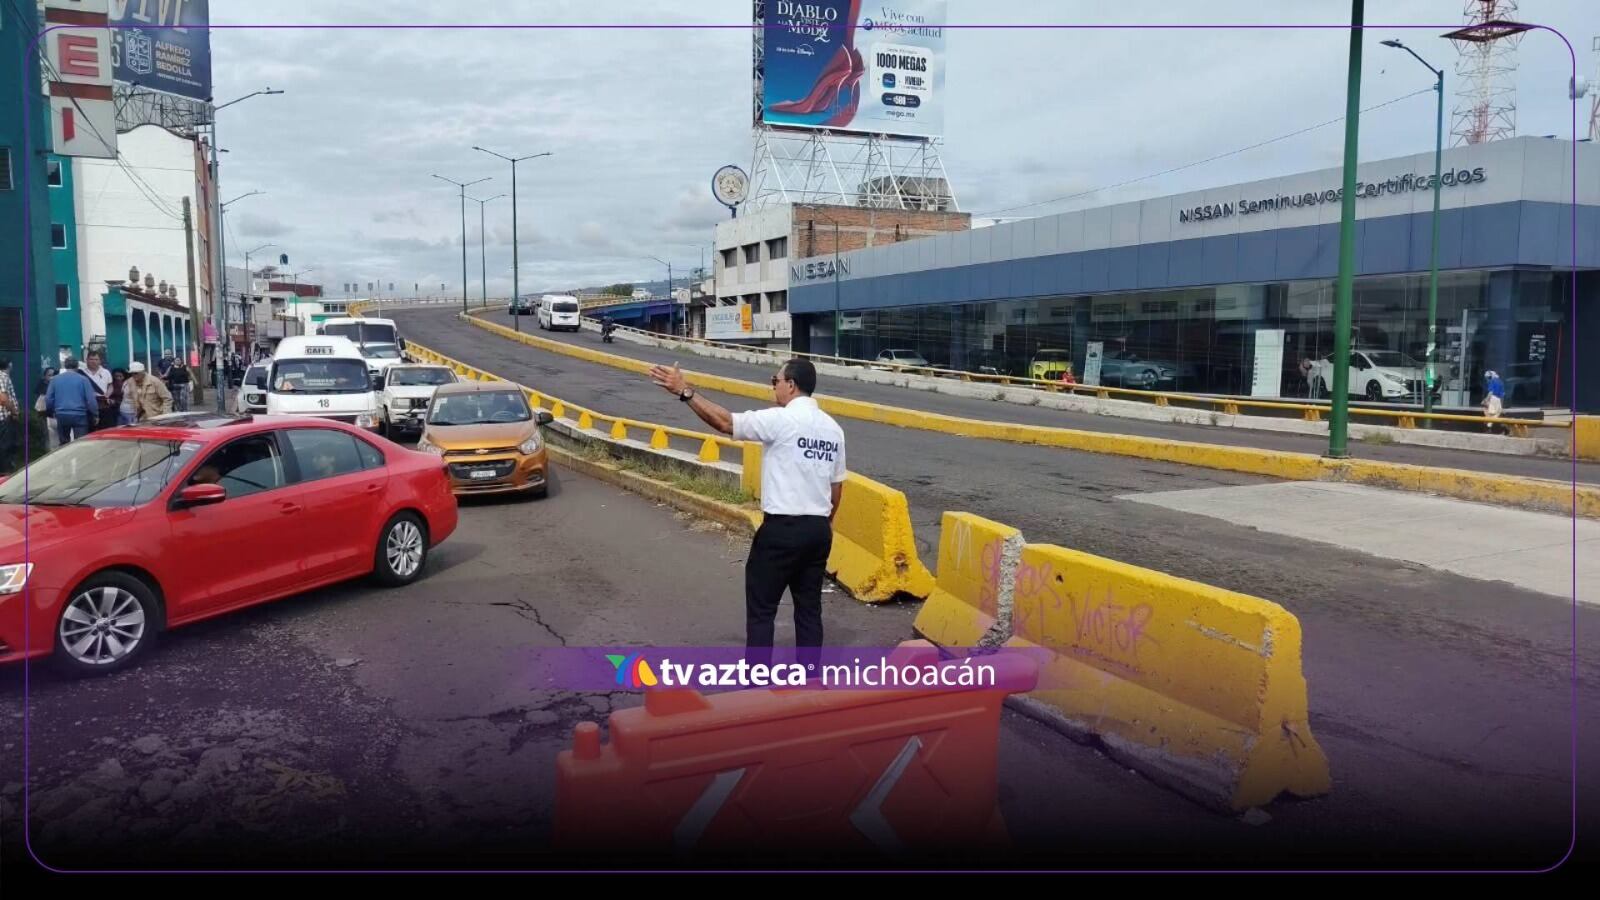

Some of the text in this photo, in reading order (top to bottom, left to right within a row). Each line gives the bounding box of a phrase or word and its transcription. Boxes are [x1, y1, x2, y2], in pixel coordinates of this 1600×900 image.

[777, 1, 837, 21] DIABLO
[881, 7, 904, 21] Vive
[155, 40, 191, 57] ALFREDO
[156, 60, 192, 77] BEDOLLA
[877, 52, 927, 72] 1000 MEGAS
[1180, 167, 1487, 223] NISSAN Seminuevos Certificados
[791, 257, 850, 281] NISSAN
[317, 399, 330, 408] 18
[803, 449, 834, 462] CIVIL
